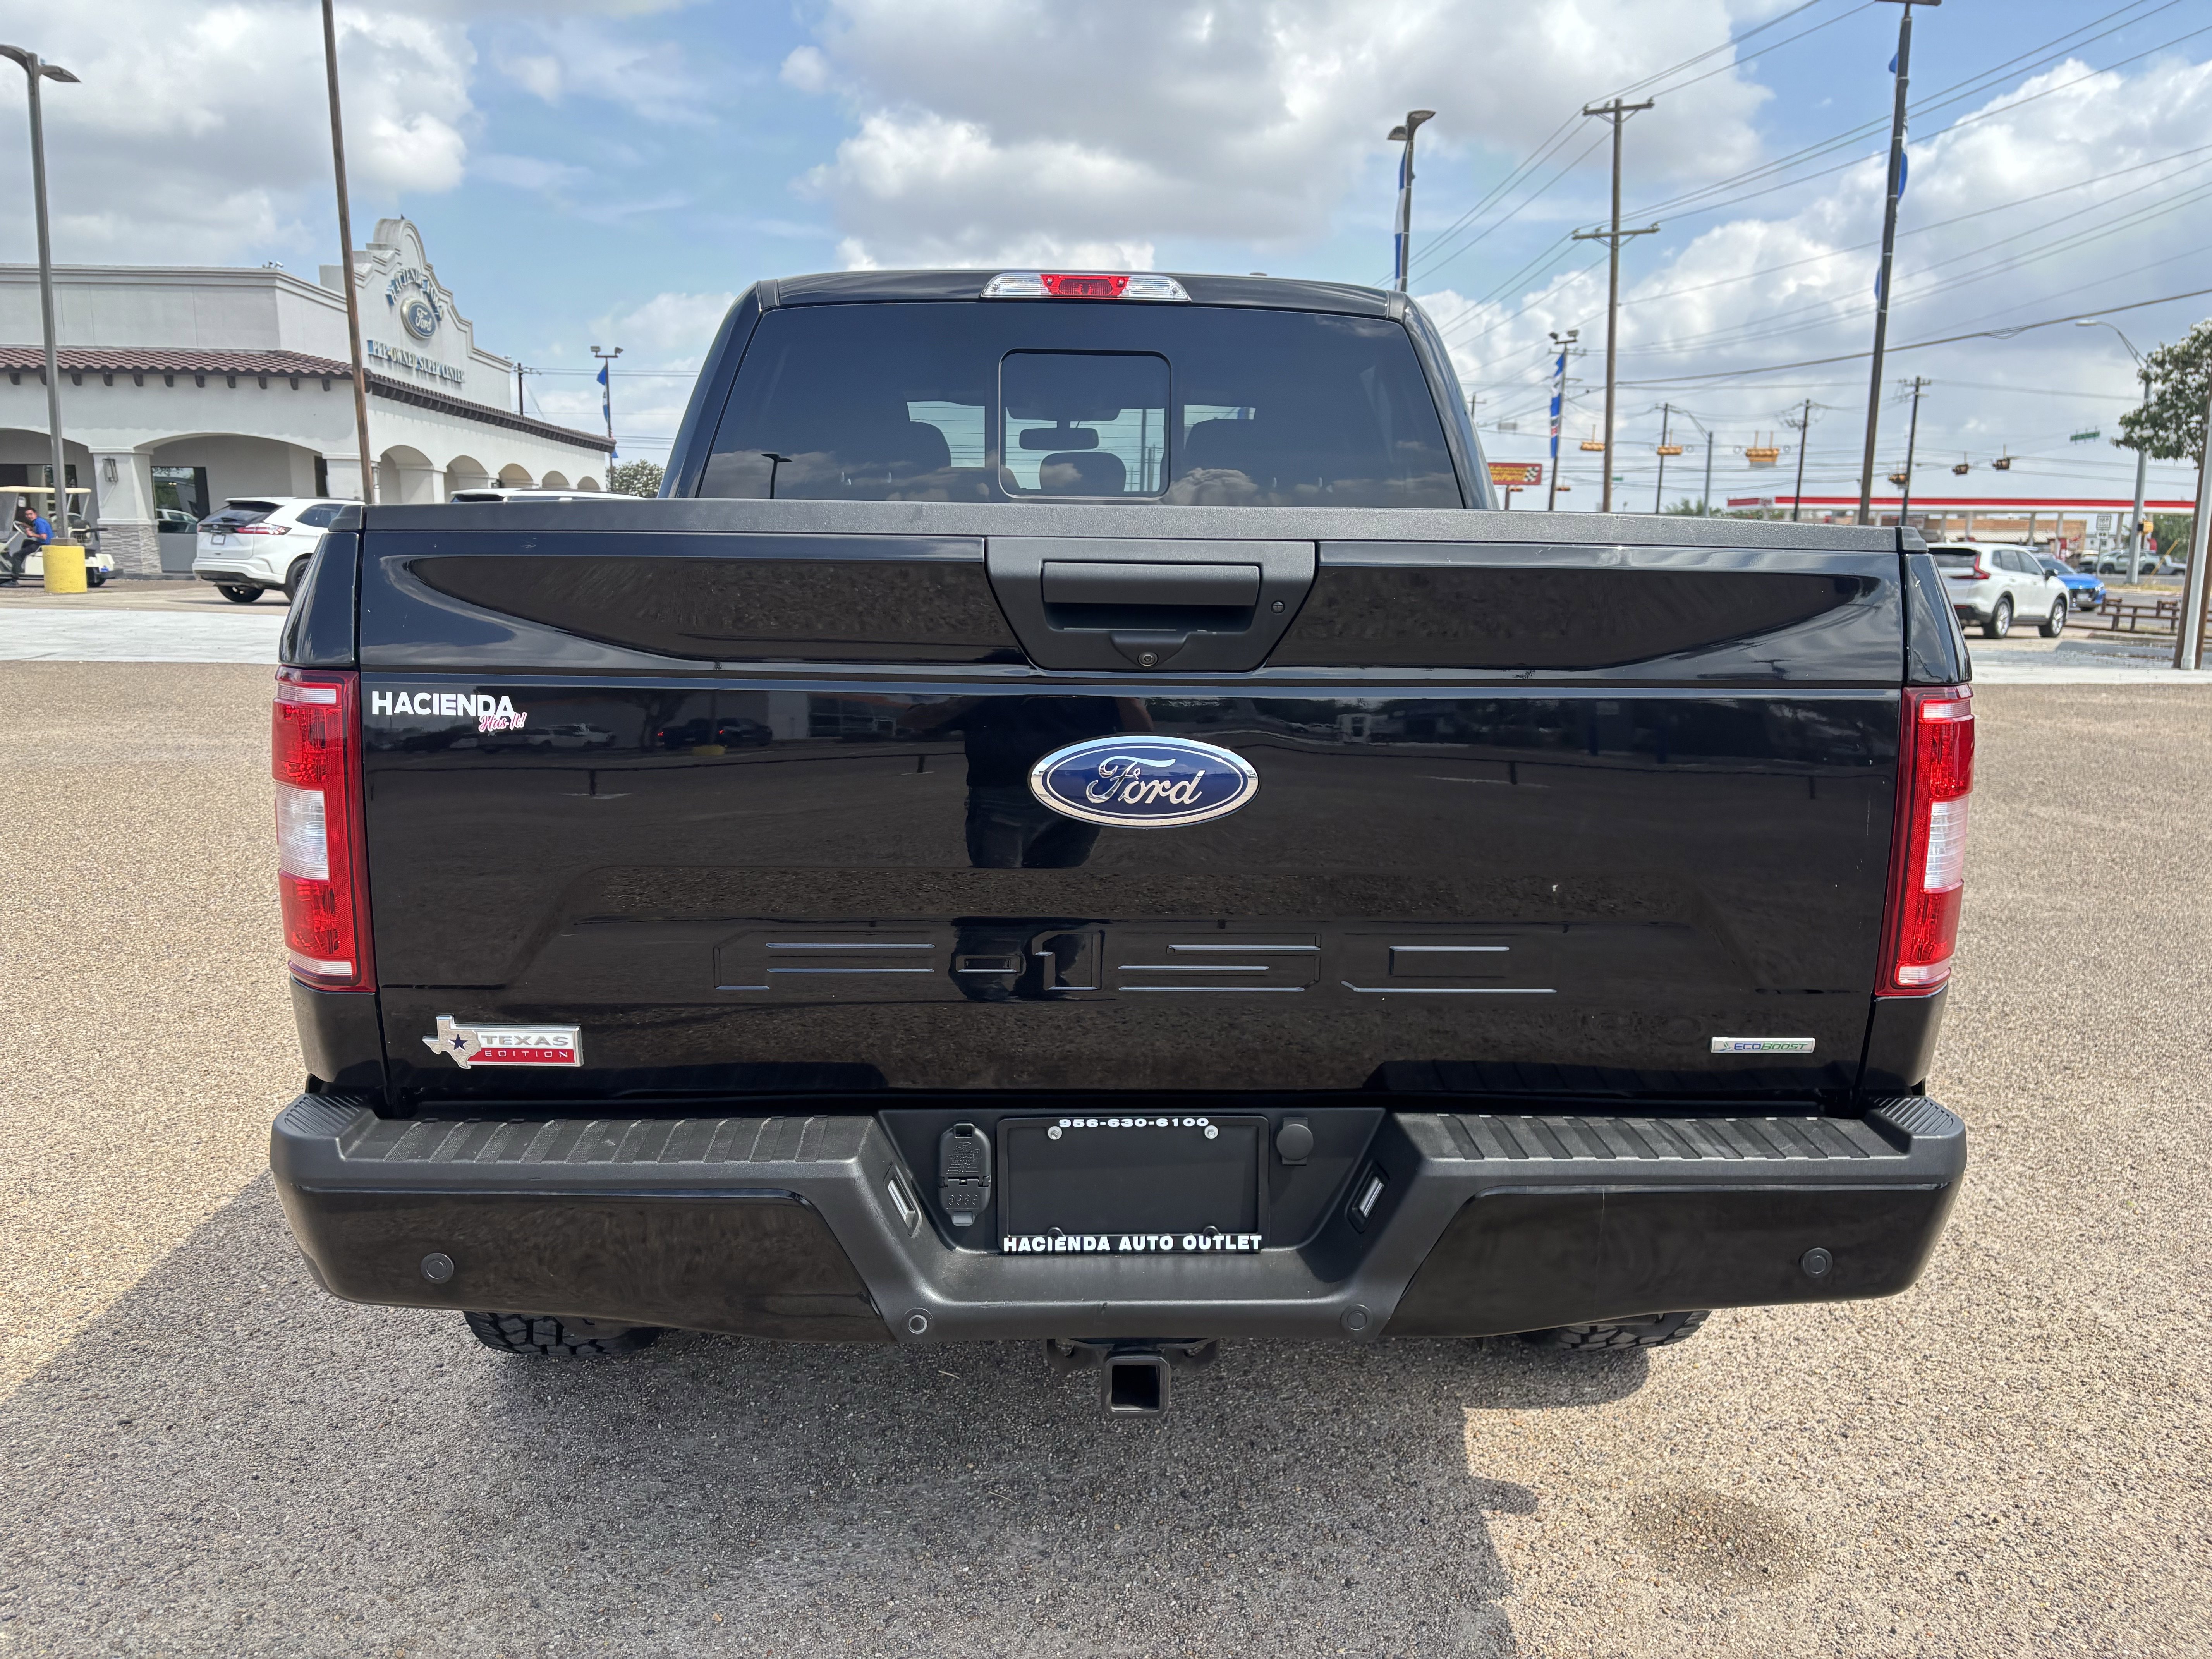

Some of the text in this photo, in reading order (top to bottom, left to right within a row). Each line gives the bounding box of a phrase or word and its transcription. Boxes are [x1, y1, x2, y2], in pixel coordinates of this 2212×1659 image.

[415, 307, 433, 332] Ford
[417, 356, 440, 376] SUPER
[441, 364, 465, 383] CENTER
[371, 691, 514, 719] HACIENDA
[478, 714, 509, 732] Has
[1086, 756, 1205, 805] Ford
[481, 1035, 569, 1046] TEXAS
[1059, 1118, 1209, 1128] 956-630-6100
[1003, 1235, 1262, 1252] HACIENDA AUTO OUTLET
